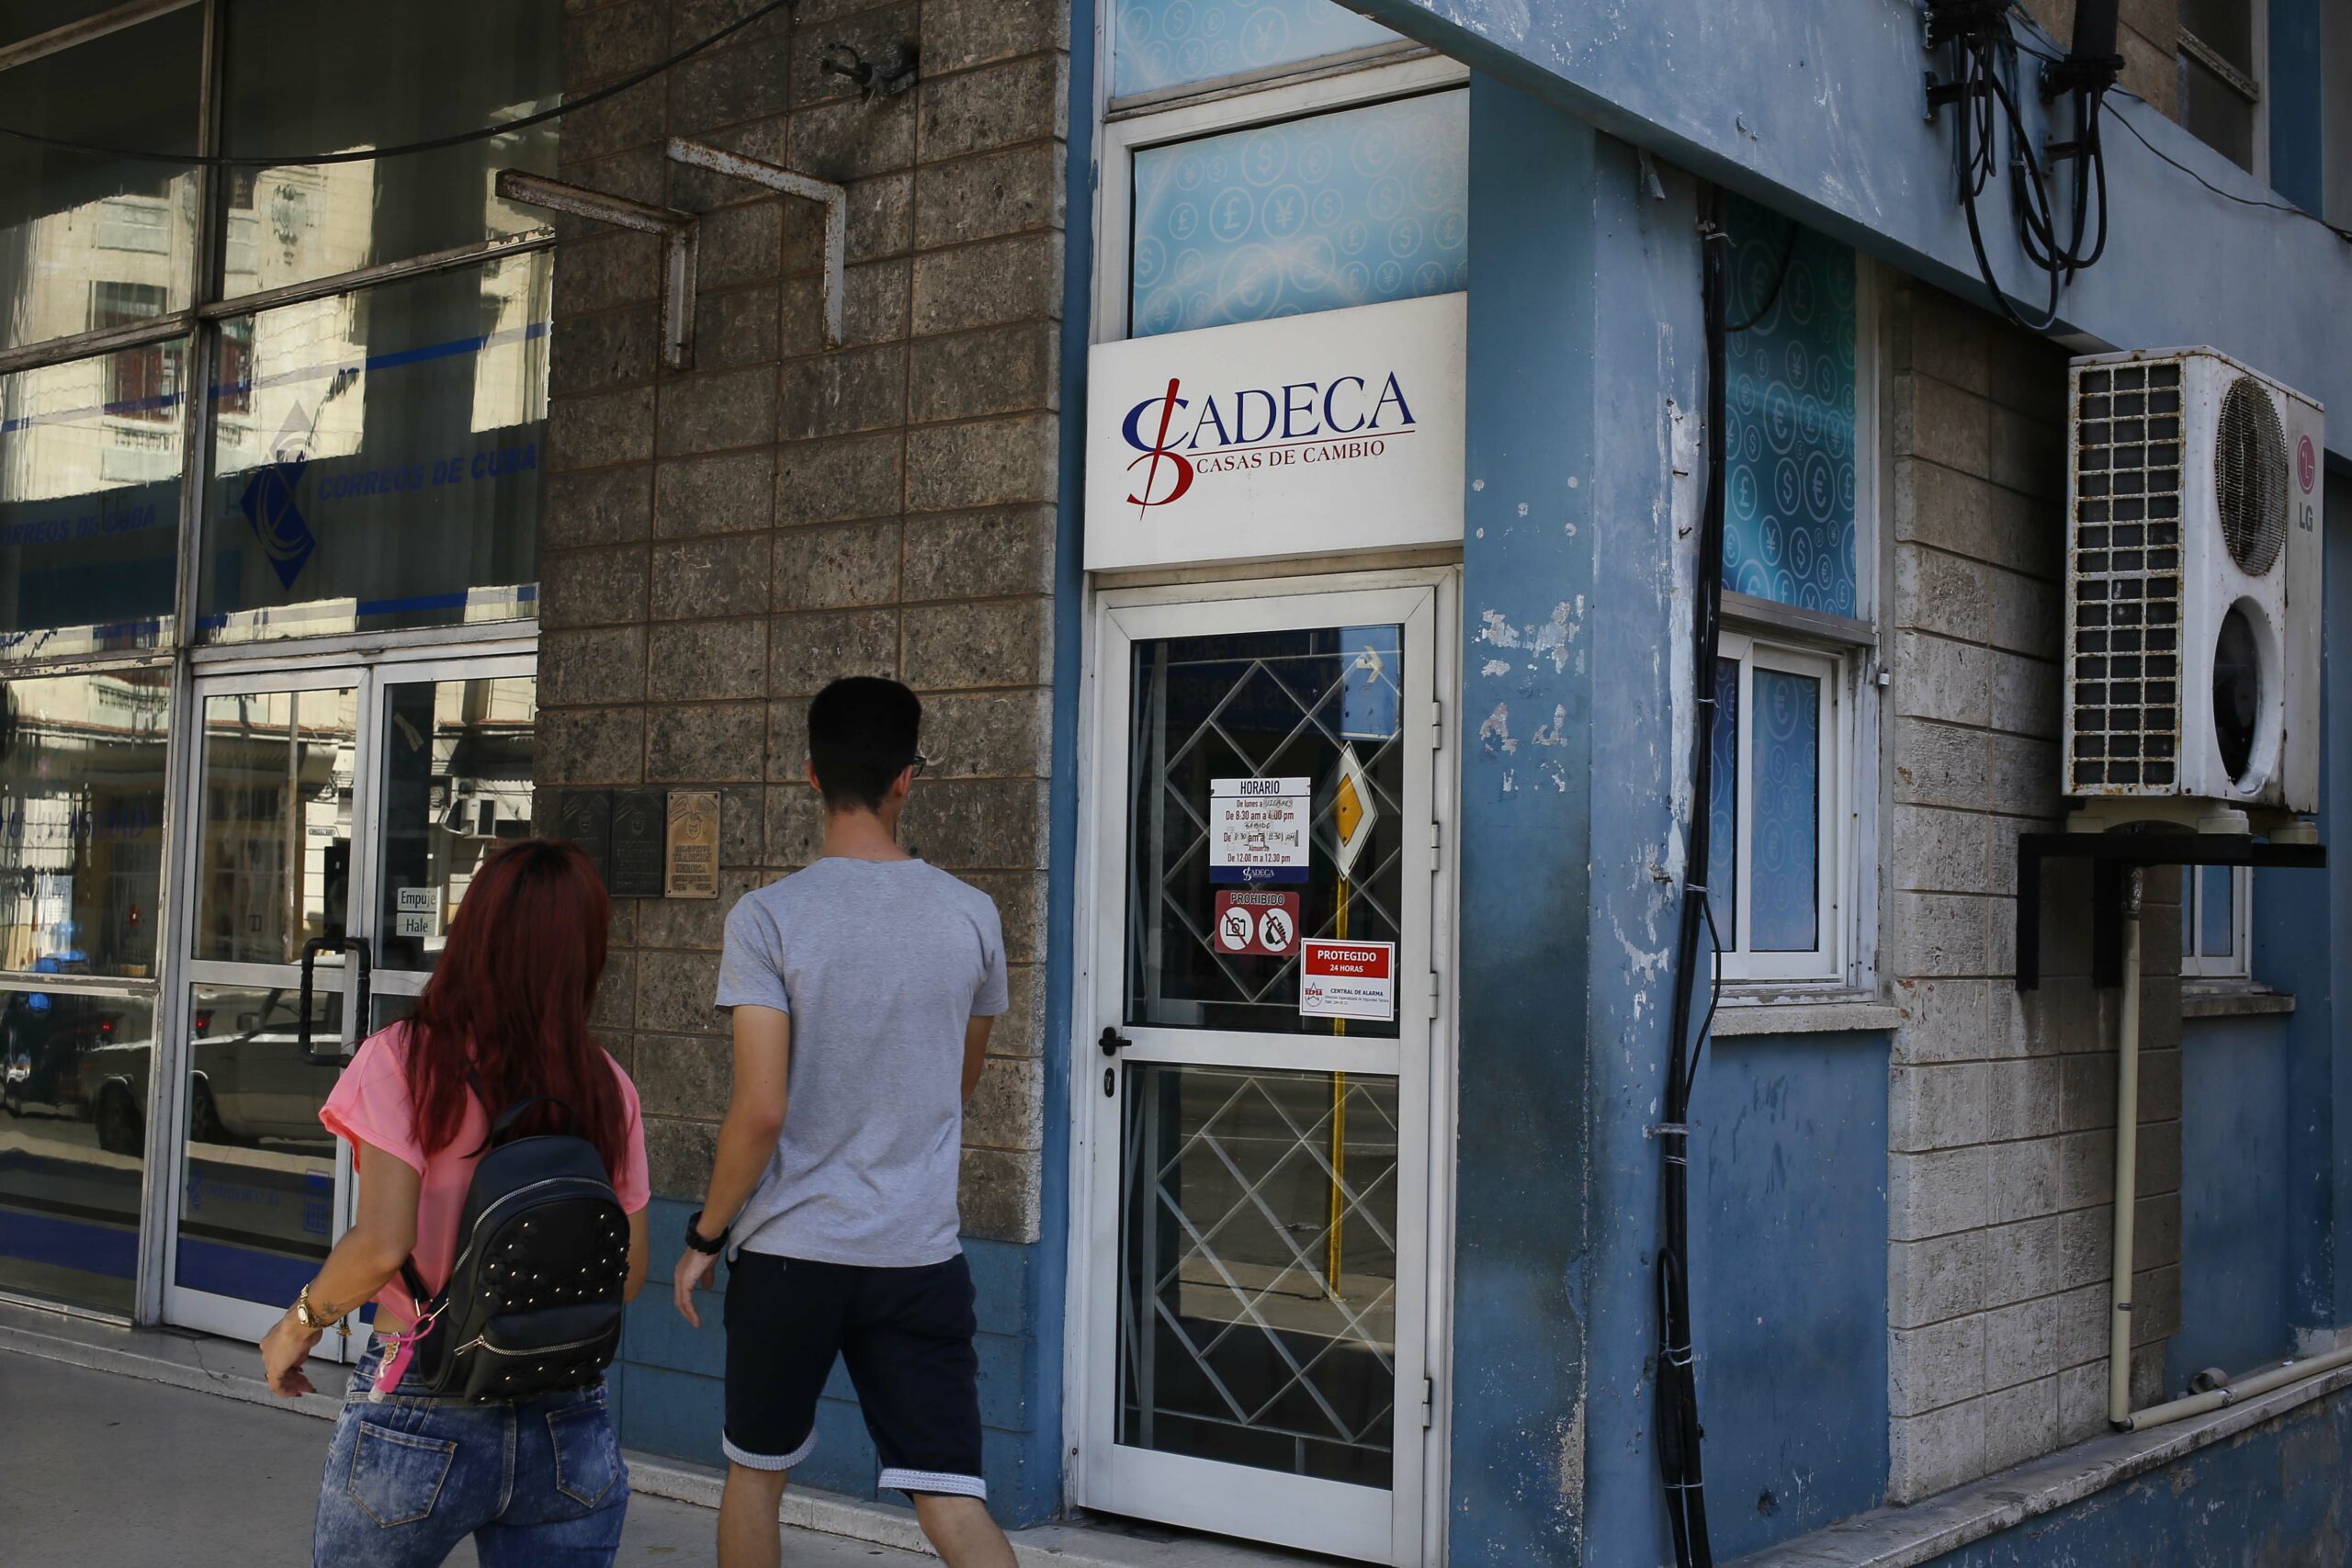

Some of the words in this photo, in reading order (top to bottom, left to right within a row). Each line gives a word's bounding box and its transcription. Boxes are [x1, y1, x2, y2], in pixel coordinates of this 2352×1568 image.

[1122, 371, 1417, 453] CADECA
[1196, 453, 1261, 474] CASAS
[1268, 449, 1295, 467] DE
[1303, 440, 1385, 462] CAMBIO
[319, 463, 423, 499] CORREOS
[431, 457, 462, 485] DE
[470, 442, 537, 479] CUBA
[2299, 502, 2313, 532] LG
[1240, 781, 1280, 795] HORARIO
[1226, 810, 1234, 820] De
[1236, 810, 1249, 820] 8:30
[1250, 812, 1261, 820] am
[1262, 812, 1266, 820] a
[1283, 812, 1294, 822] pm
[1224, 832, 1231, 841] De
[1227, 853, 1235, 863] De
[1237, 853, 1251, 863] 12:00
[1265, 853, 1280, 863] 12:30
[1282, 855, 1290, 864] pm
[1243, 867, 1274, 878] CADECA
[401, 891, 435, 908] Empuje
[1230, 893, 1284, 906] PROHIBIDO
[406, 919, 428, 932] Hale
[1317, 950, 1376, 962] PROTEGIDO
[1329, 964, 1339, 972] 24
[1340, 964, 1363, 973] HORAS
